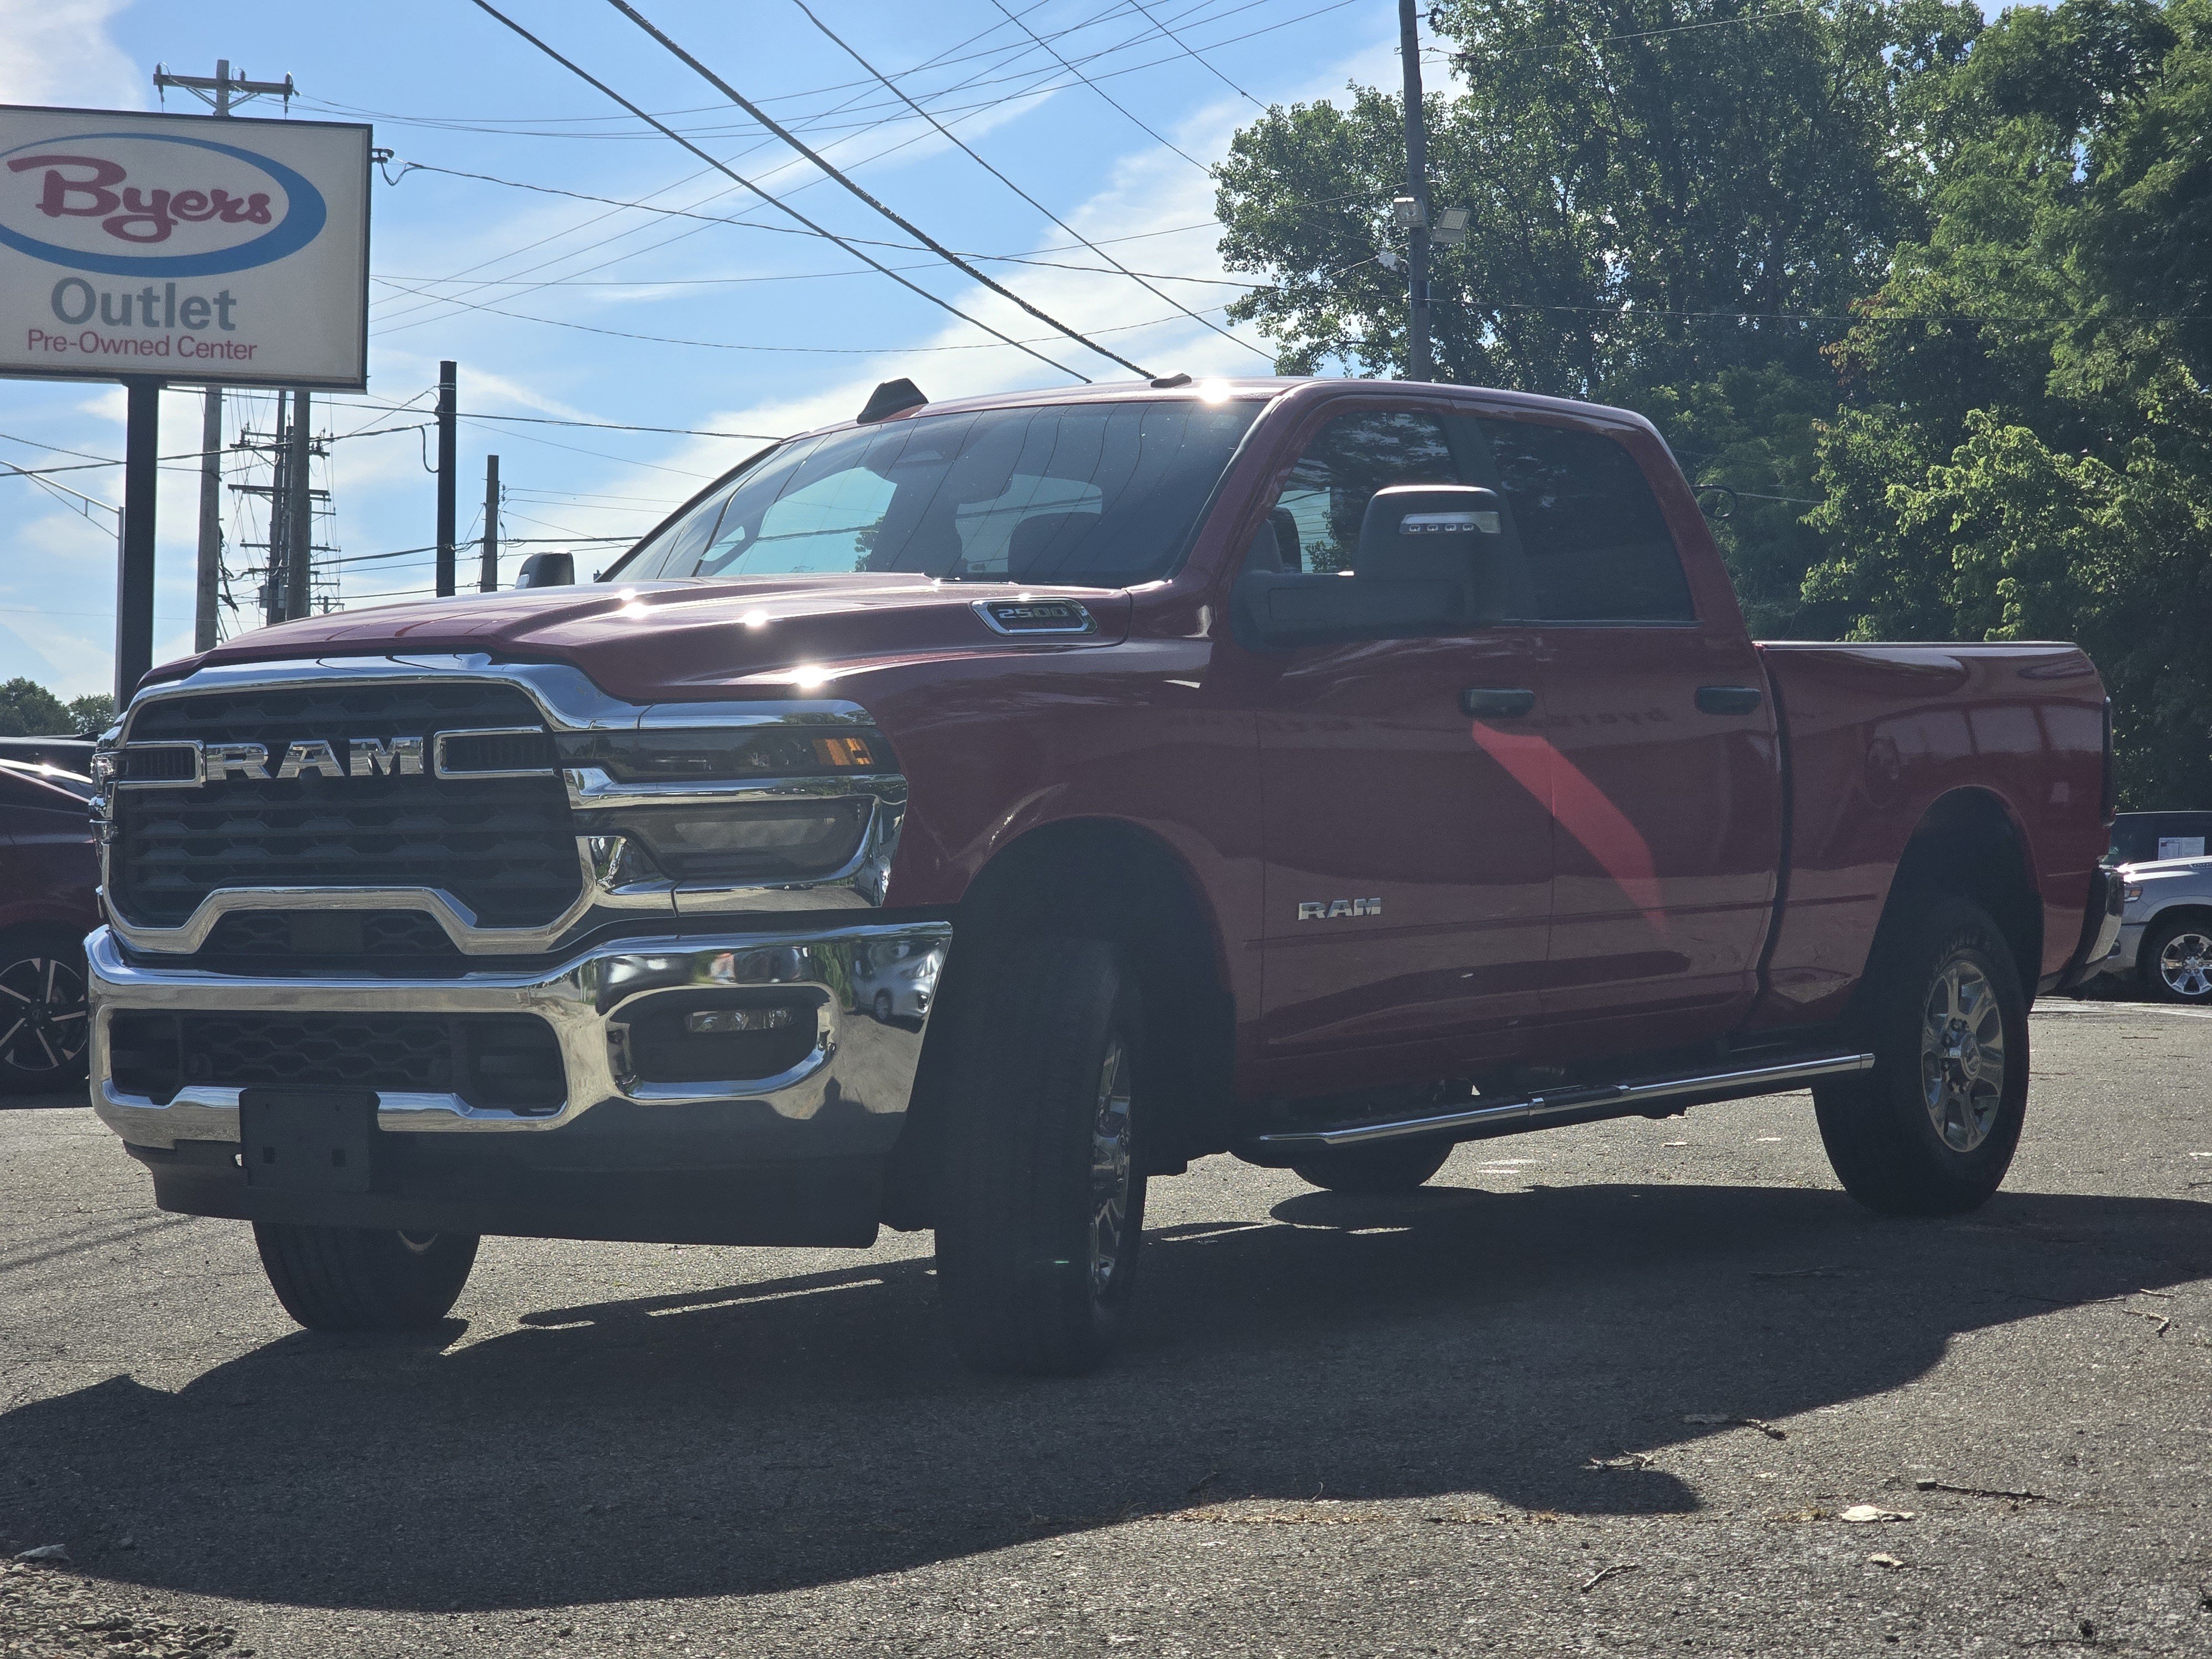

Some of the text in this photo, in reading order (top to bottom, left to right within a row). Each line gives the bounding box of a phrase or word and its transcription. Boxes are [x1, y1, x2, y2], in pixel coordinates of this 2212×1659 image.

[7, 155, 272, 243] Byers
[51, 277, 237, 331] Outlet
[28, 330, 258, 360] Pre-Owned Center
[998, 608, 1069, 618] 2500
[206, 737, 424, 779] RAM
[1298, 898, 1381, 920] RAM
